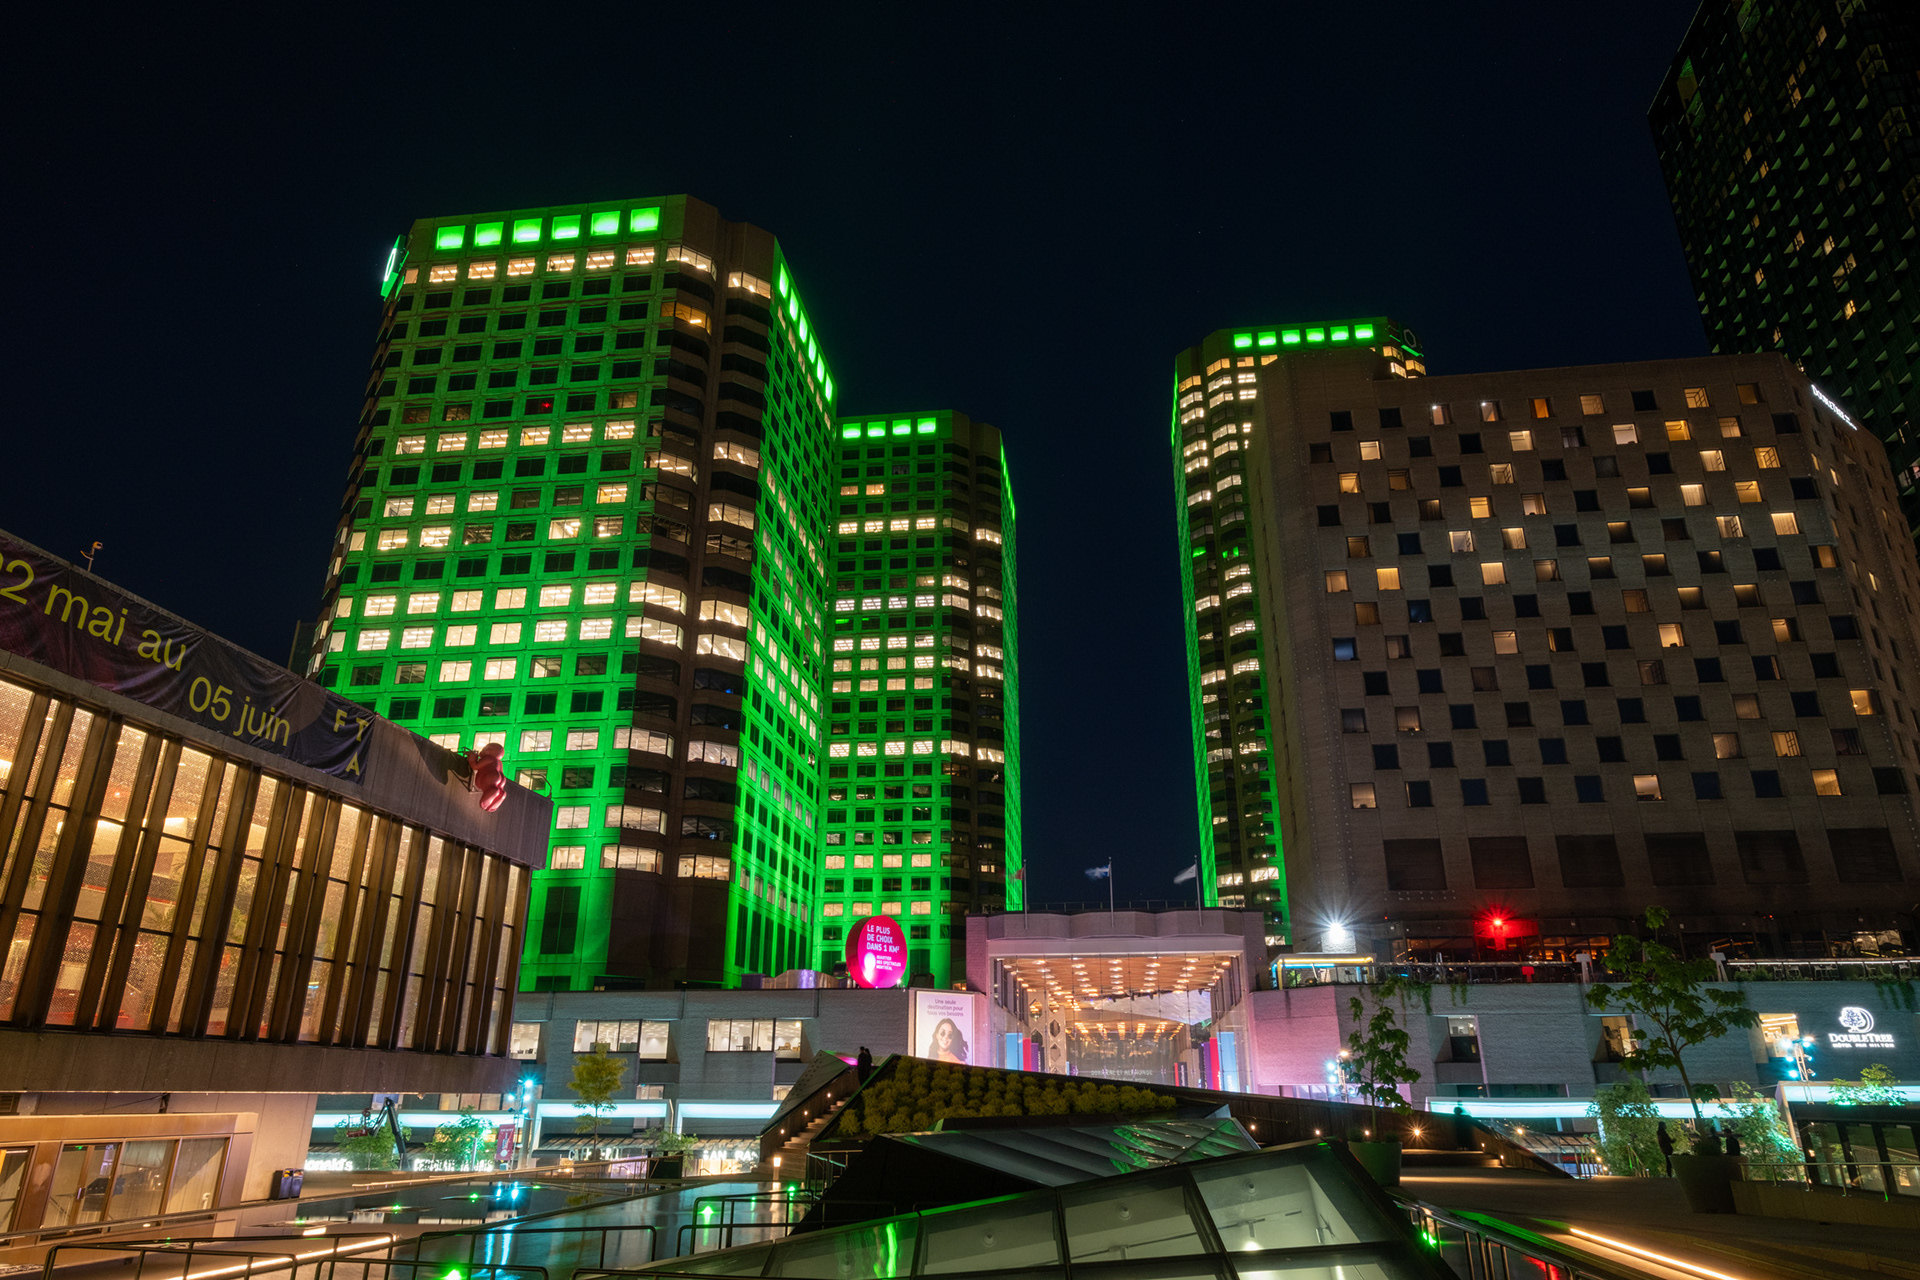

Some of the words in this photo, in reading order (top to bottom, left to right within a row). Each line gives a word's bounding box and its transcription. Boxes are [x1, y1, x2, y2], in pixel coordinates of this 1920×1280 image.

[0, 551, 35, 605] 2
[44, 583, 129, 646] mai
[137, 629, 187, 672] au
[188, 676, 234, 722] 05
[232, 695, 291, 747] juin
[867, 924, 874, 932] LE
[876, 925, 890, 934] PLUS
[867, 933, 874, 941] DE
[876, 935, 893, 944] CHOIX
[866, 942, 882, 951] DANS
[883, 944, 887, 952] 1
